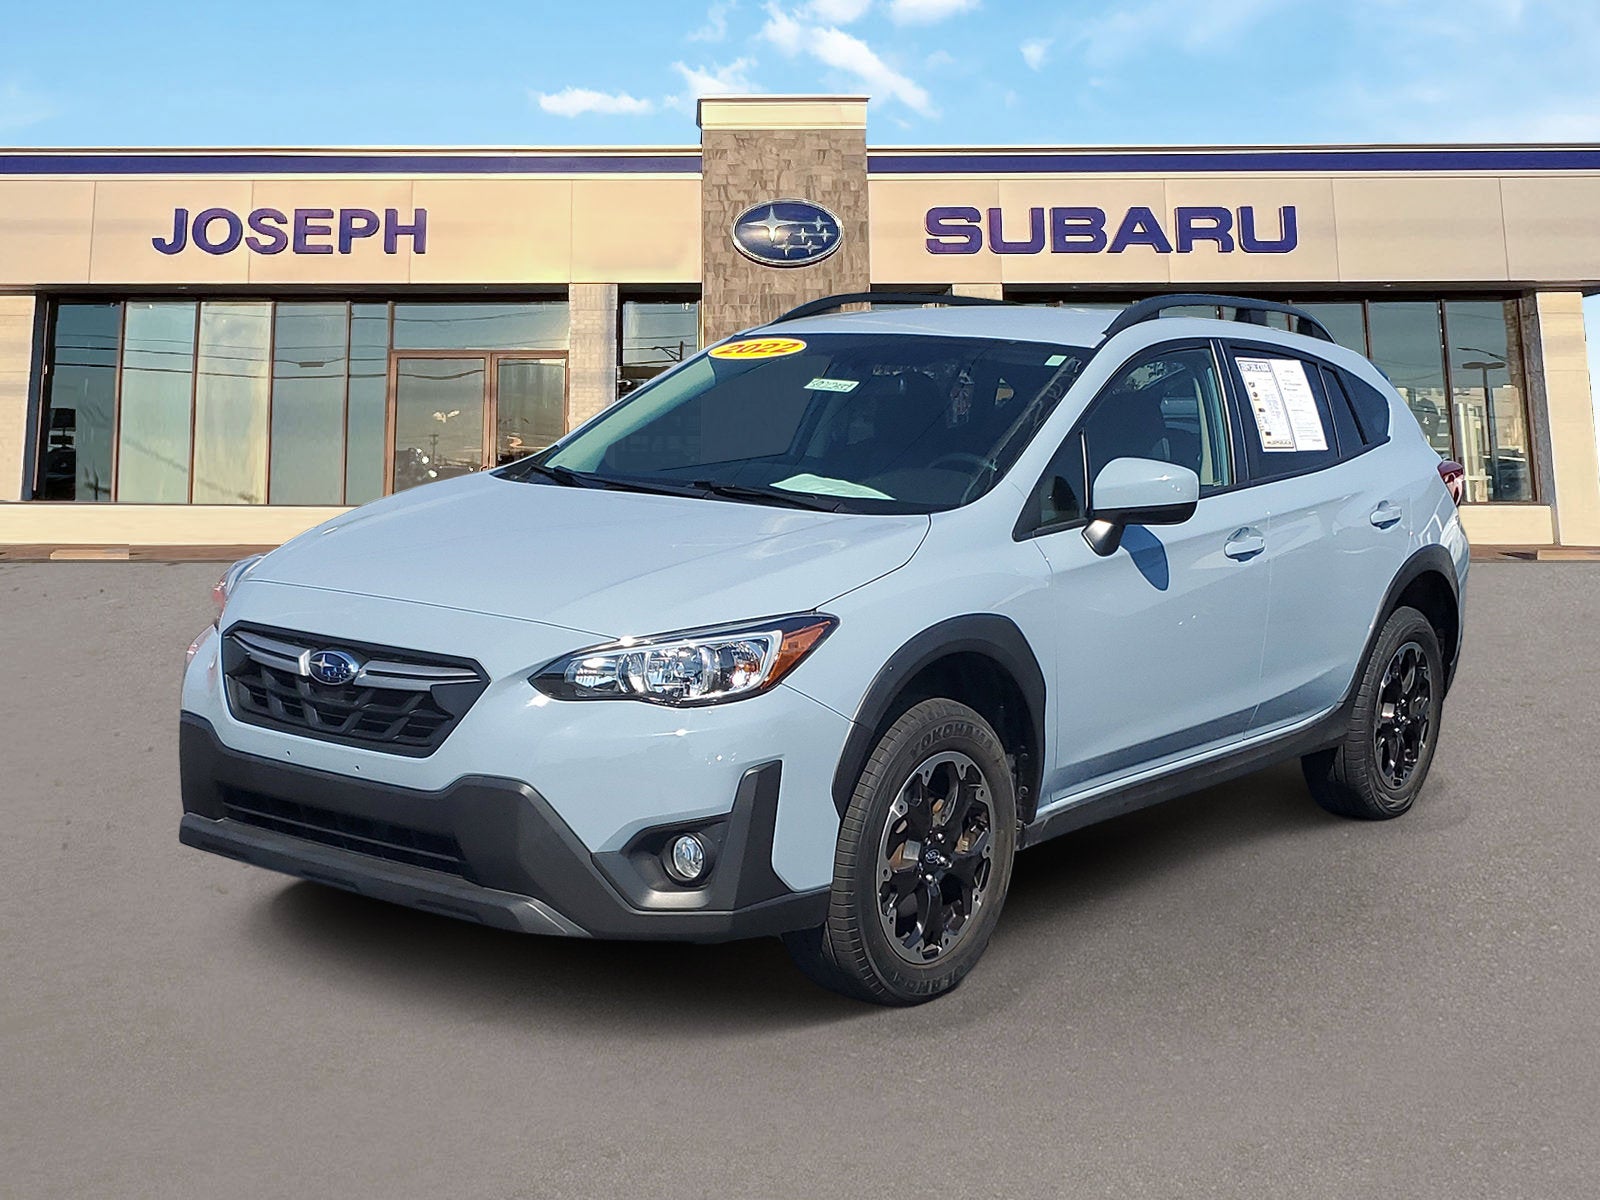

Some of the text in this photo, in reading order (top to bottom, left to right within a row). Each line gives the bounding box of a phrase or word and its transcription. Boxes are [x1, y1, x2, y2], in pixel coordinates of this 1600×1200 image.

[152, 206, 1298, 255] JOSEPH SUBARU
[715, 343, 800, 354] 2022
